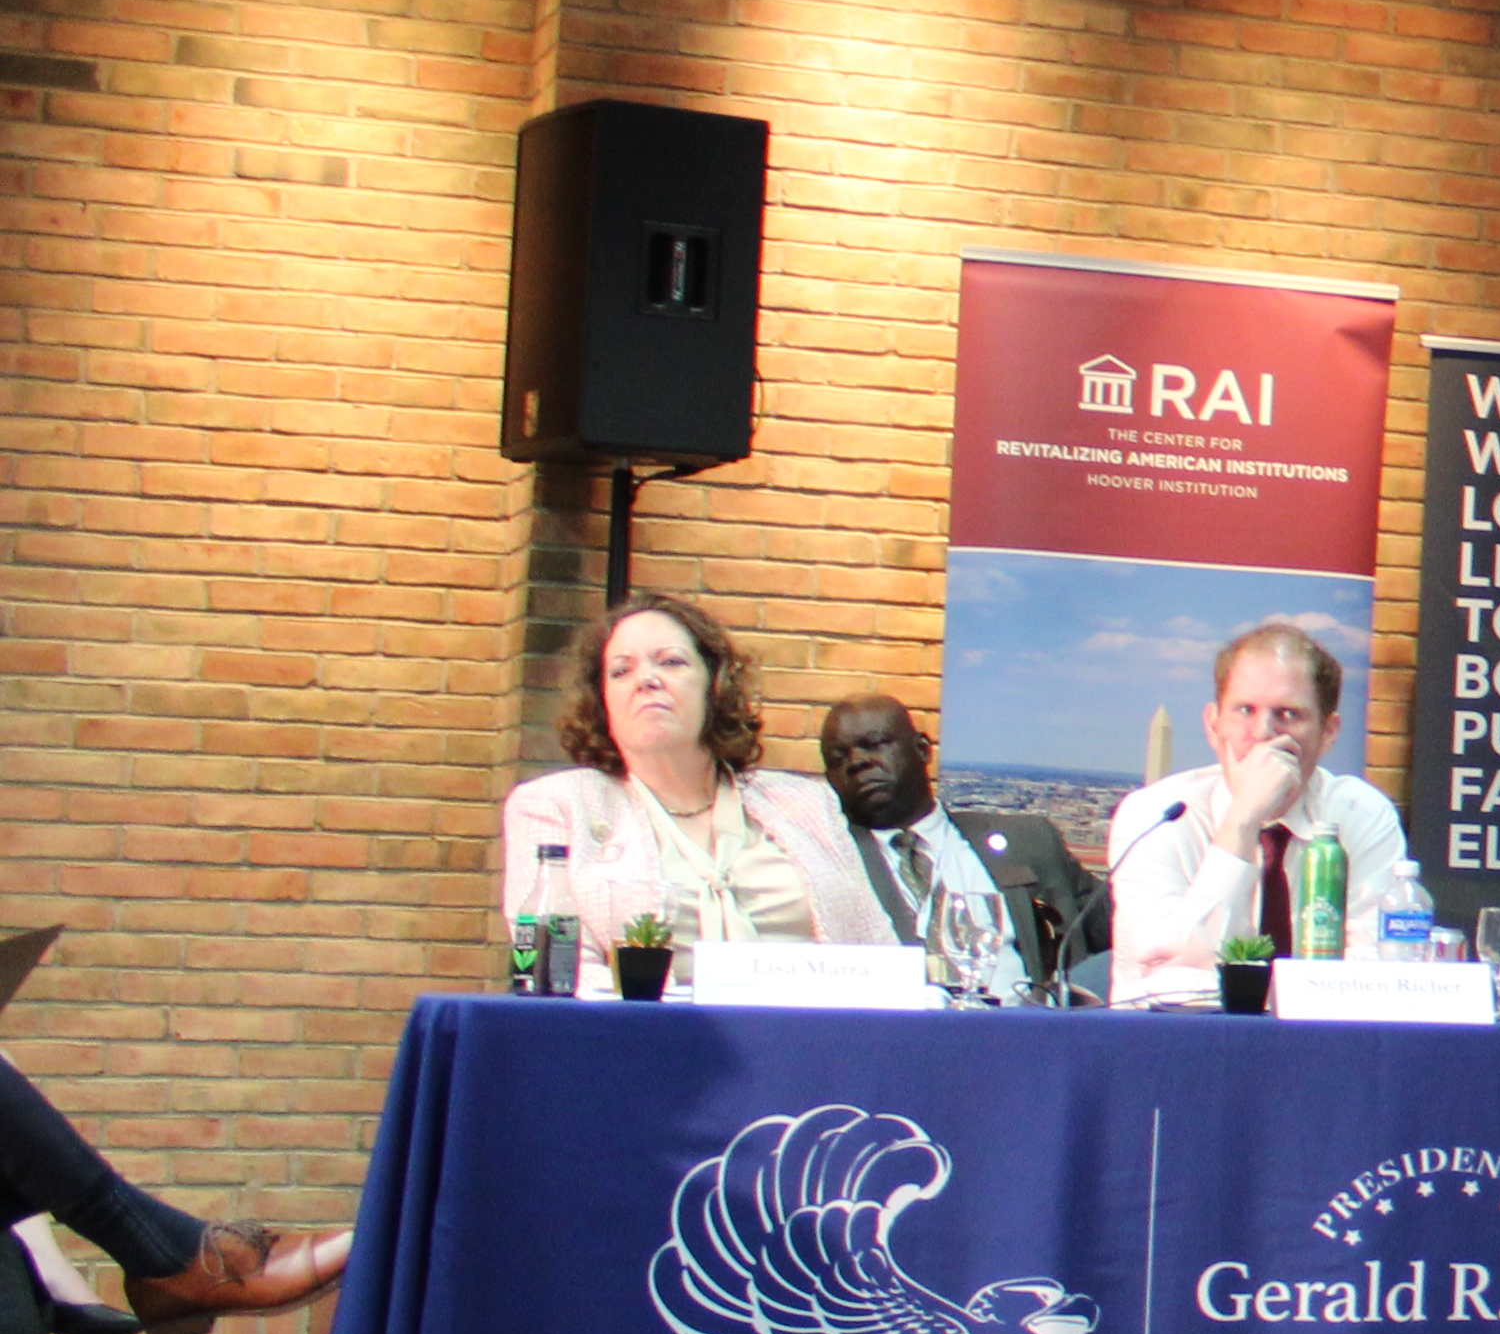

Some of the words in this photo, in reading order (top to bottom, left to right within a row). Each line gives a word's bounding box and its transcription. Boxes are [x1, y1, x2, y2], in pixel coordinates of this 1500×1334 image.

[1150, 363, 1275, 427] RAI
[1108, 427, 1139, 444] THE
[1143, 430, 1206, 450] CENTER
[1209, 435, 1244, 453] FOR
[996, 440, 1122, 465] REVITALIZING
[1126, 450, 1223, 474] AMERICAN
[1226, 459, 1349, 483] INSTITUTIONS
[1086, 472, 1154, 492] HOOVER
[1158, 479, 1259, 500] INSTITUTION
[752, 958, 797, 975] Lisa
[1307, 976, 1389, 995] Stephen
[1396, 977, 1462, 994] Richer
[1197, 1260, 1426, 1323] Gerald
